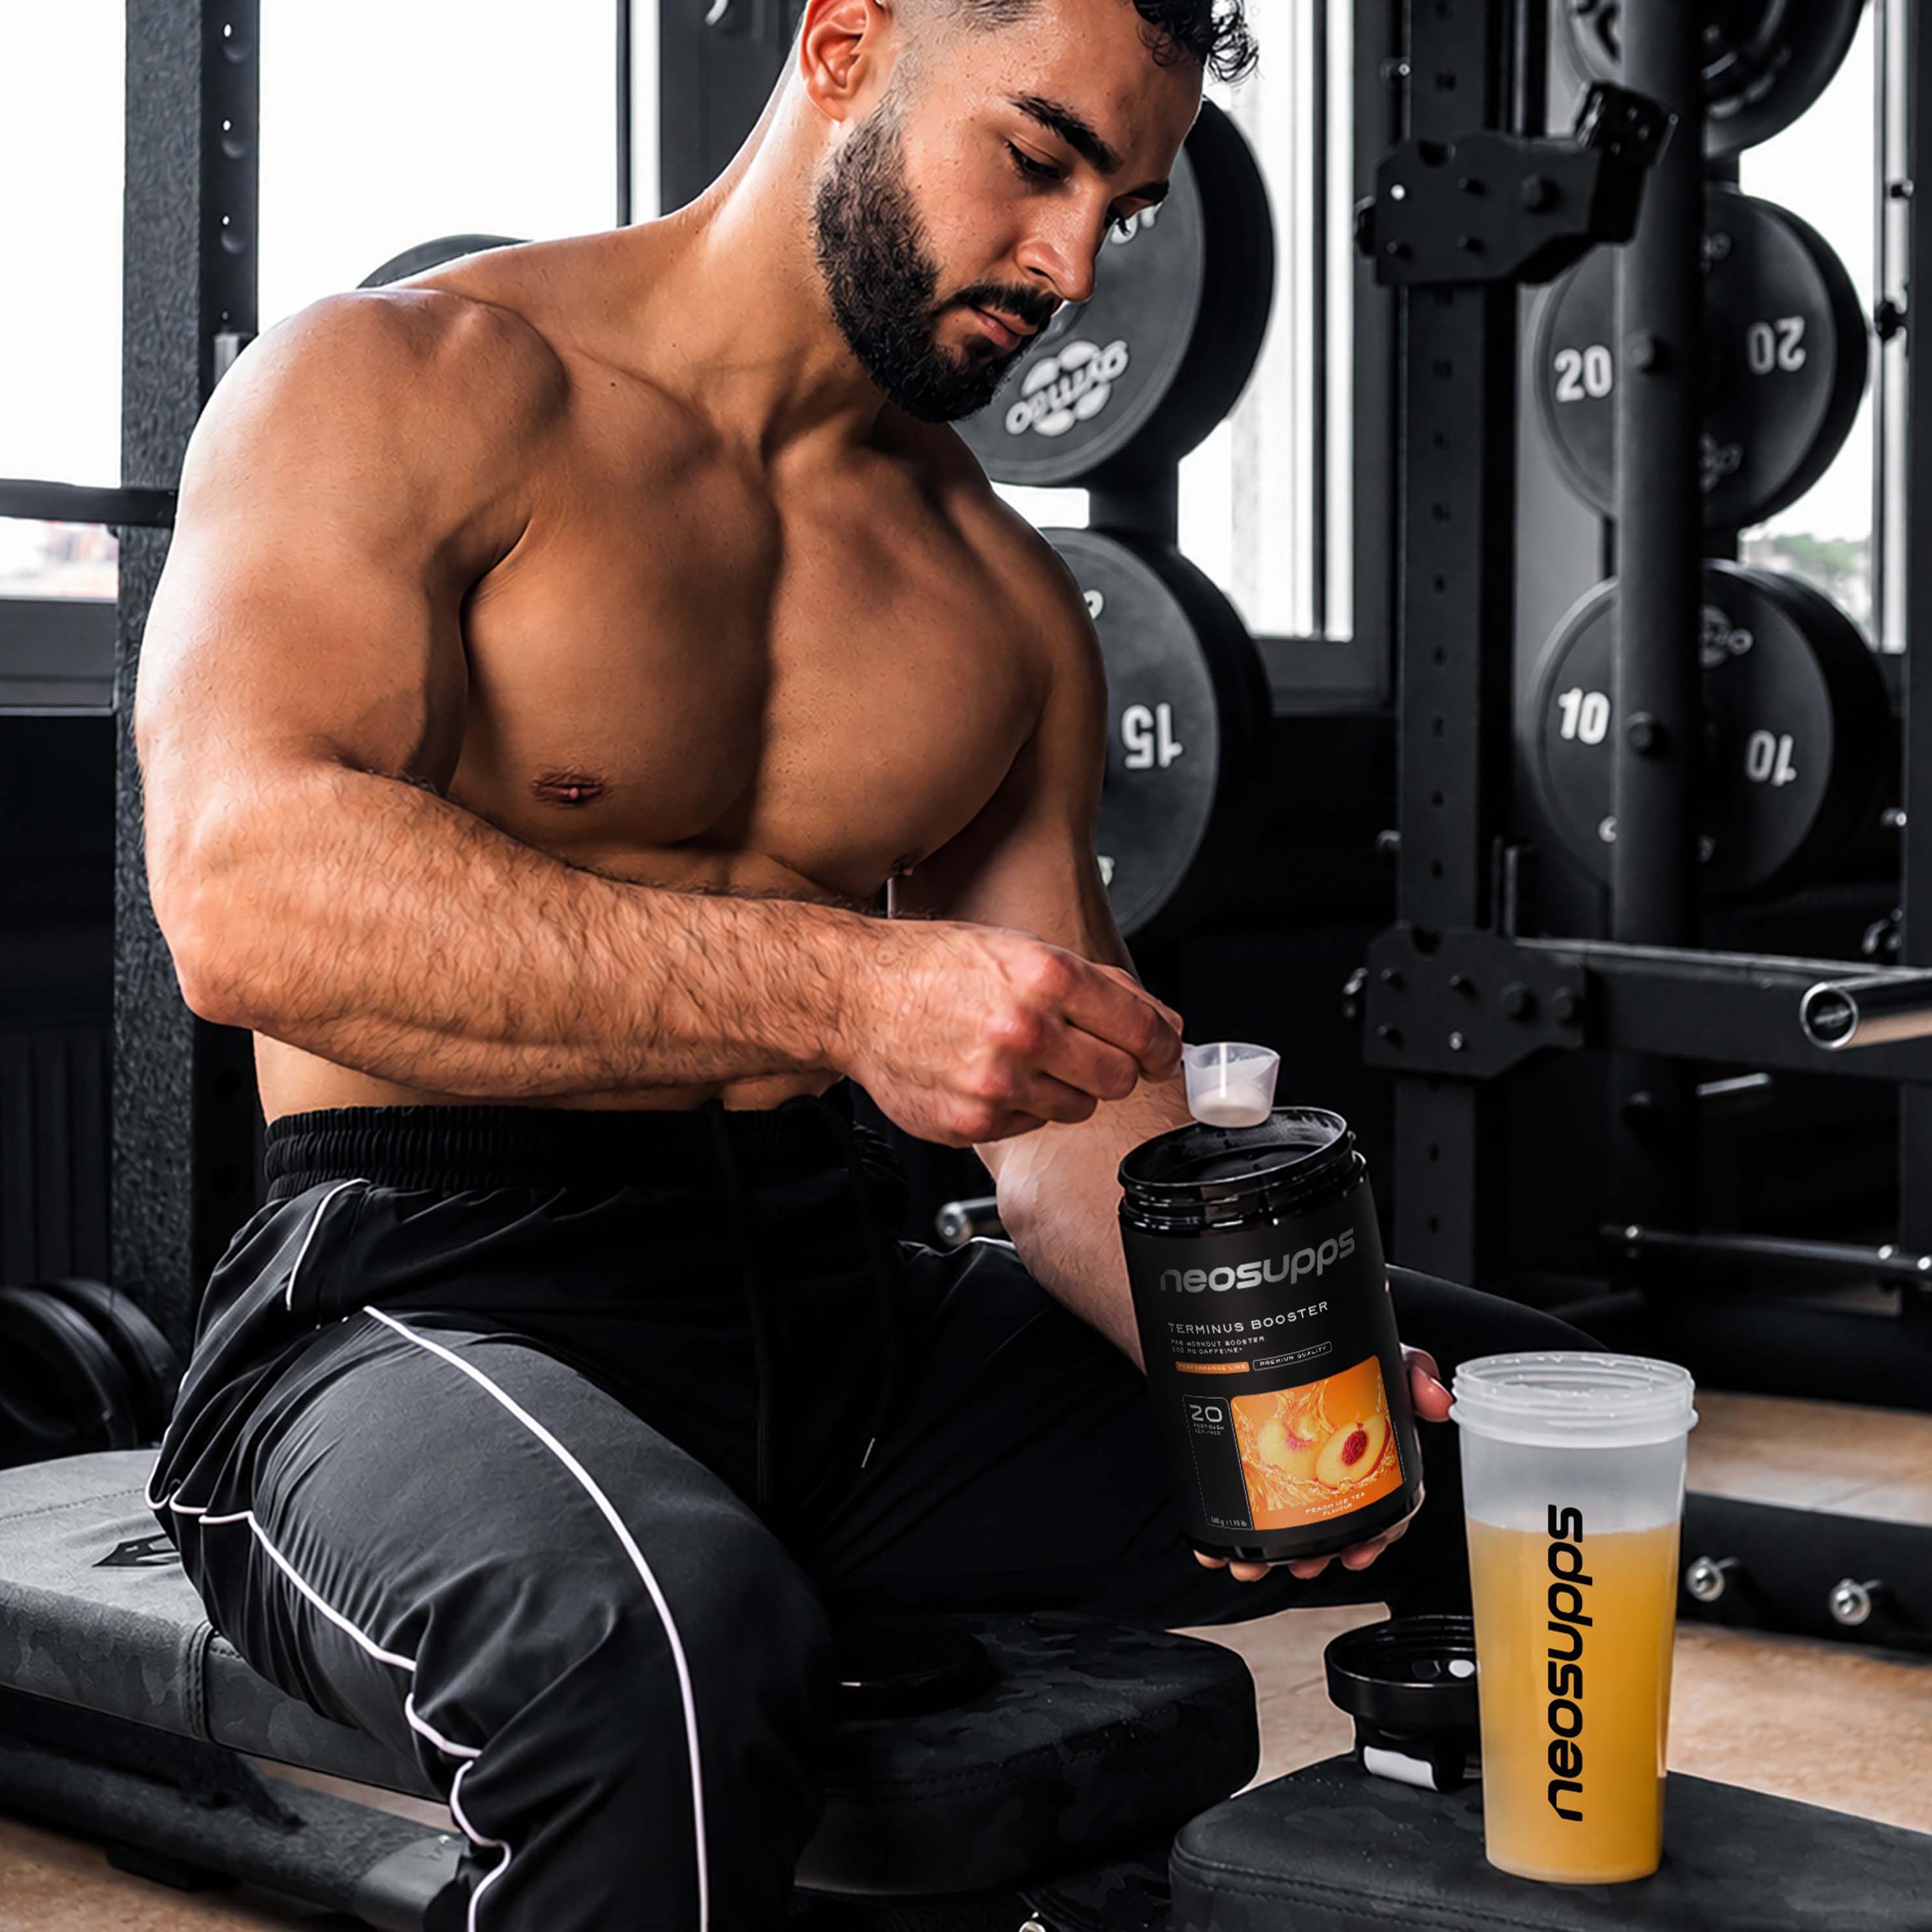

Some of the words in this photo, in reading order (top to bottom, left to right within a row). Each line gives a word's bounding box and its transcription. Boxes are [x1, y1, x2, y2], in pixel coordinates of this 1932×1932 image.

[1749, 315, 1807, 374] 20
[1554, 345, 1613, 402] 20
[1122, 703, 1184, 769] 15
[1558, 687, 1610, 745] 10
[1746, 729, 1797, 787] 10
[1160, 1227, 1355, 1293] neosupps
[1168, 1322, 1244, 1335] TERMINUS
[1251, 1301, 1328, 1330] BOOSTER
[1225, 1335, 1265, 1346] BOOSTER
[1260, 1355, 1294, 1366] PREMIUM
[1297, 1345, 1327, 1359] QUALITY
[1189, 1404, 1223, 1422] 20
[1305, 1503, 1334, 1515] PEACH
[1351, 1492, 1365, 1502] TEA
[1547, 1504, 1593, 1823] neosupps
